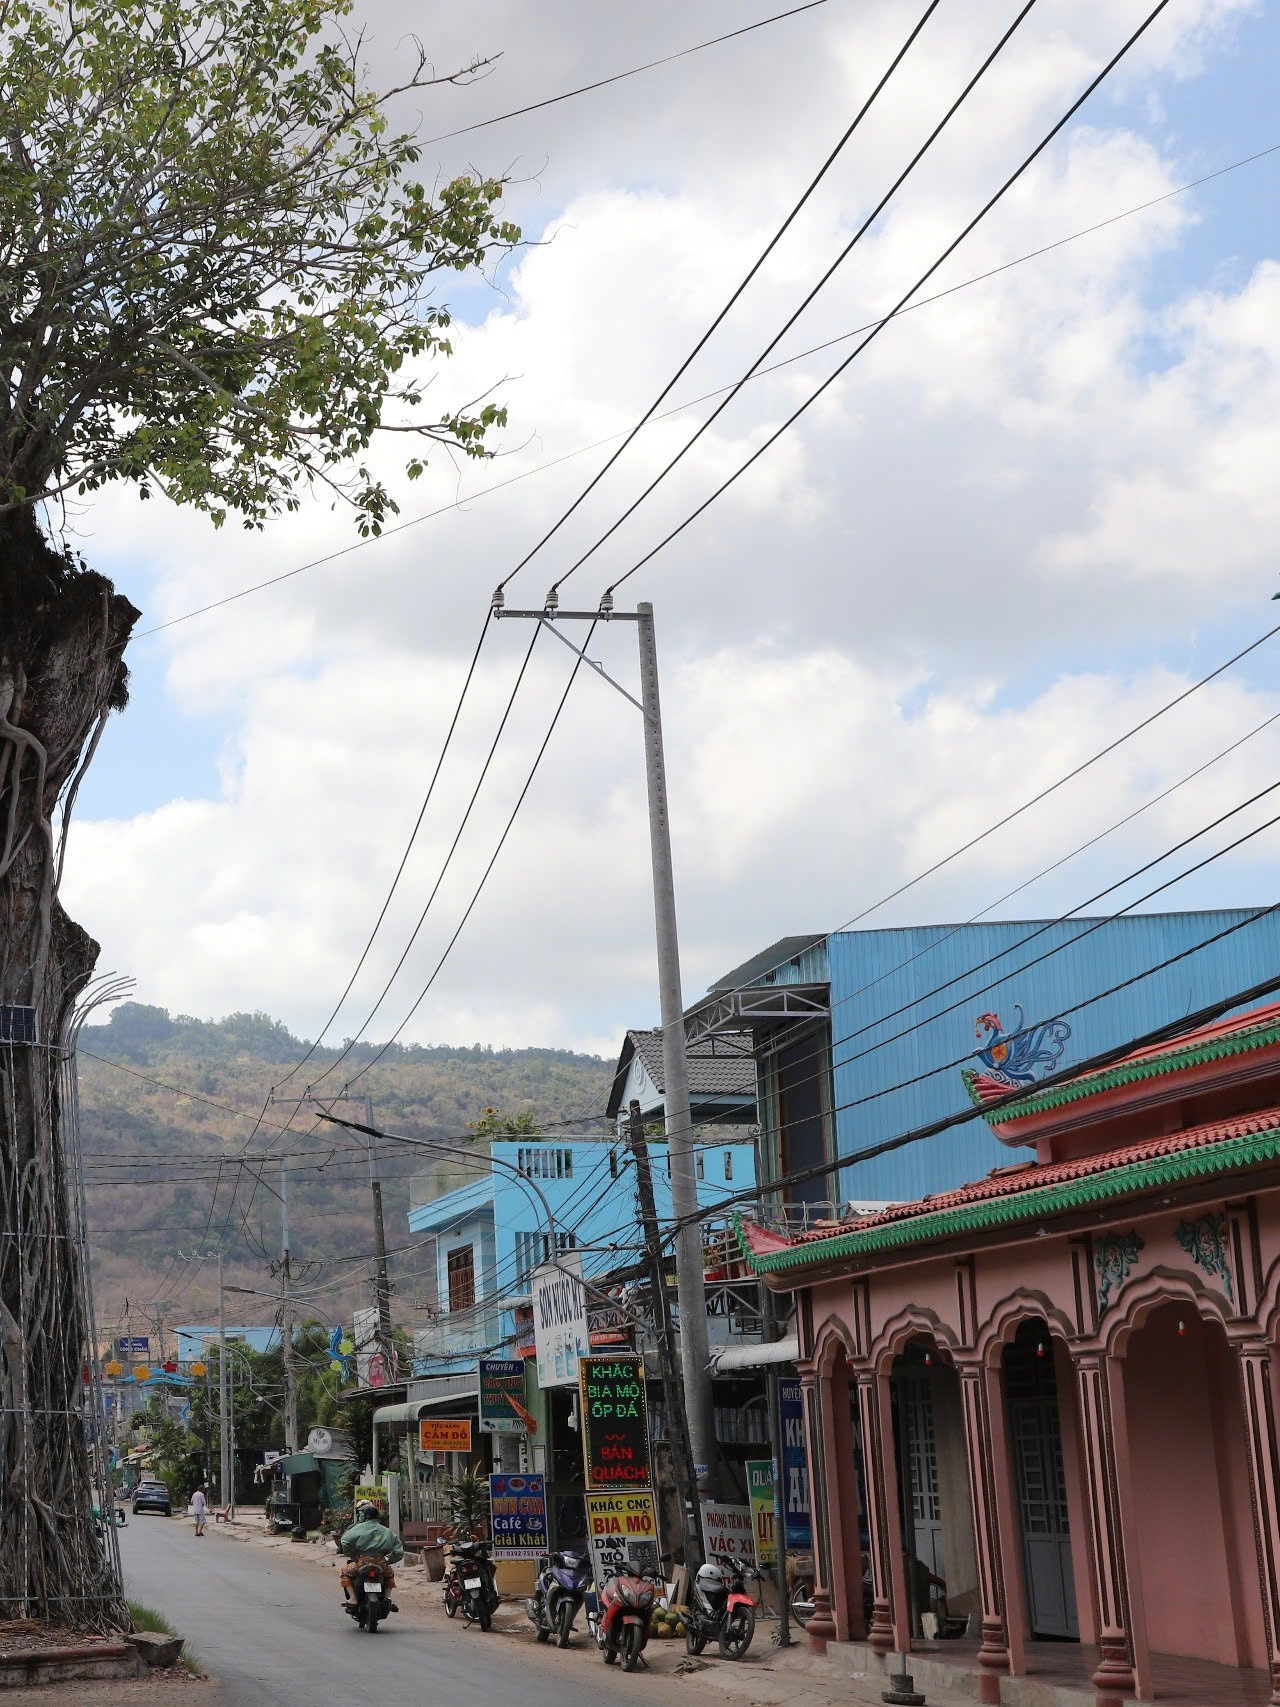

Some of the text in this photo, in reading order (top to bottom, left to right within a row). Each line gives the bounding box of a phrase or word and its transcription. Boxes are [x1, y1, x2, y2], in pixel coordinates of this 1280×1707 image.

[591, 1363, 633, 1379] KHẮC
[587, 1380, 641, 1400] BIA MỘ
[615, 1401, 639, 1418] ĐÁ
[592, 1463, 647, 1481] QUÁCH
[752, 1465, 773, 1488] QUÁ
[590, 1496, 651, 1512] KHẮC CNC
[493, 1516, 522, 1530] Café
[593, 1510, 652, 1535] BIA MỘ
[494, 1532, 546, 1546] Giải Khát
[709, 1531, 736, 1553] VẮC
